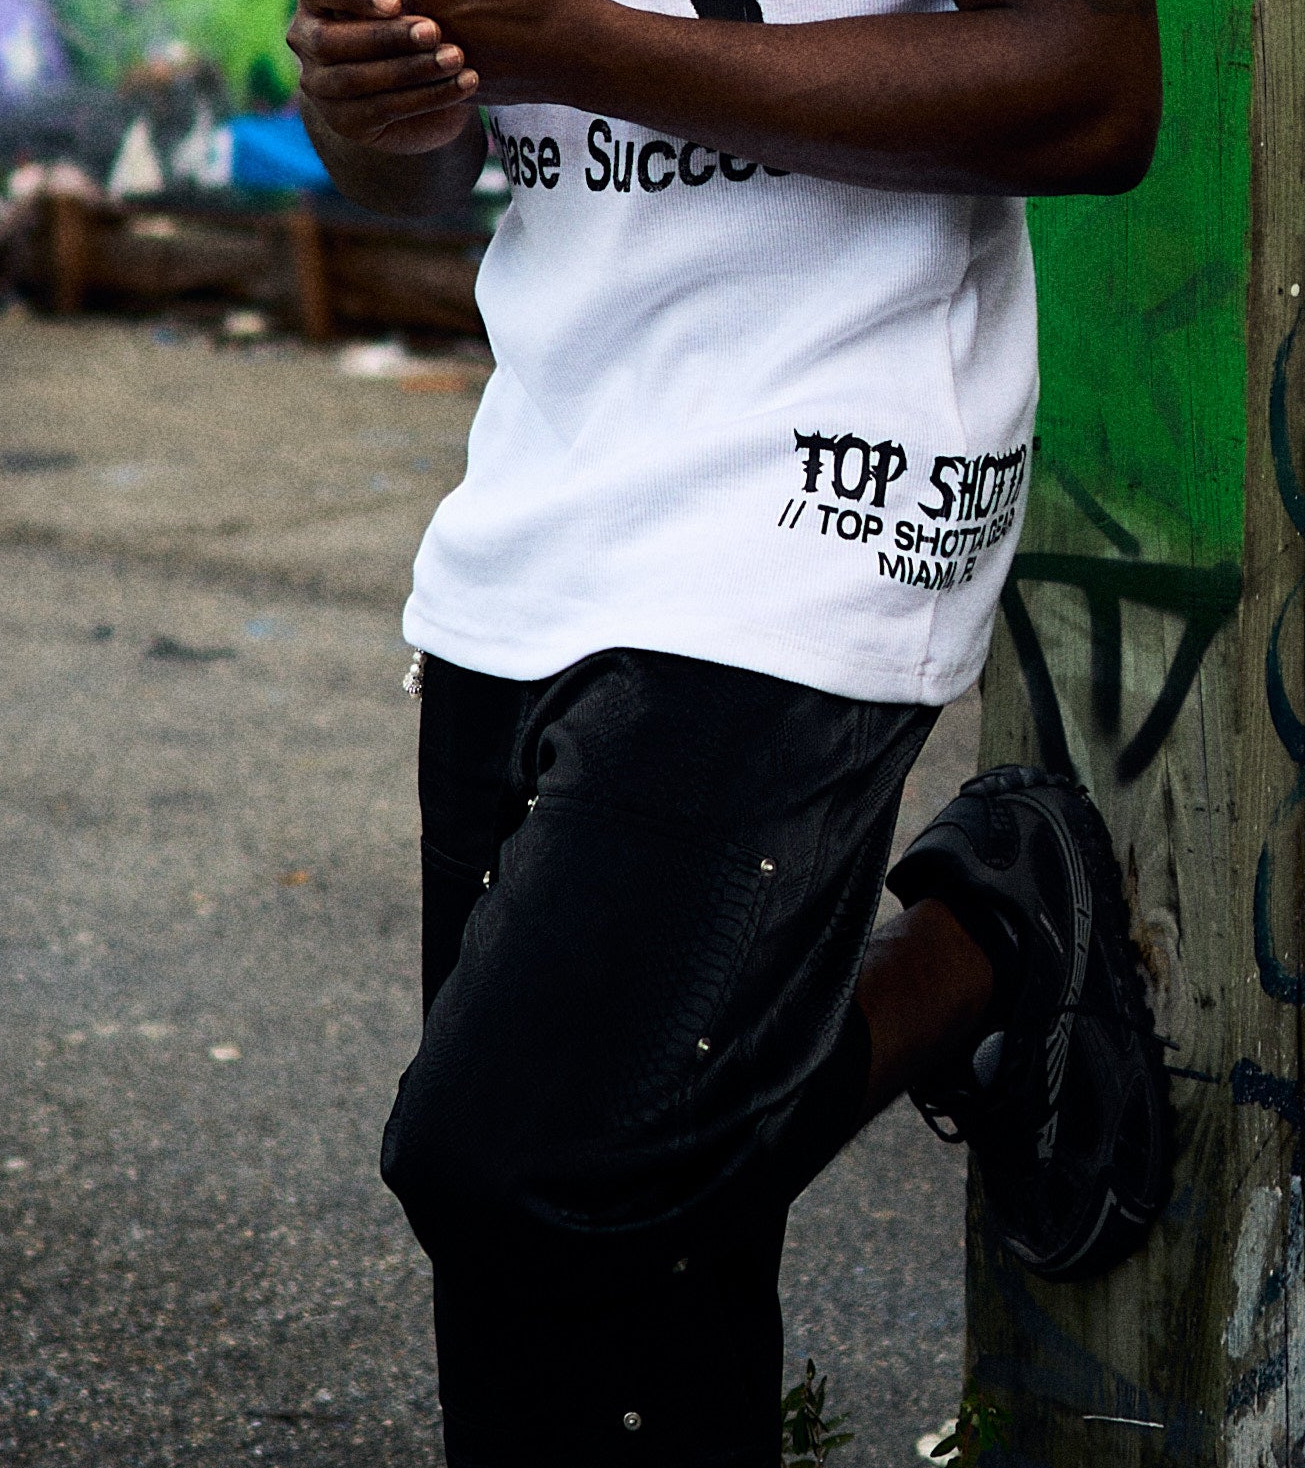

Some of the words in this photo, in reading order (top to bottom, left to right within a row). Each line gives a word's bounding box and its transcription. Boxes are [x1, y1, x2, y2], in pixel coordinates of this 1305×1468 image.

[585, 118, 791, 193] Succe
[794, 428, 907, 507] TOP
[817, 504, 883, 543] TOP
[894, 520, 986, 558] SHOTTA
